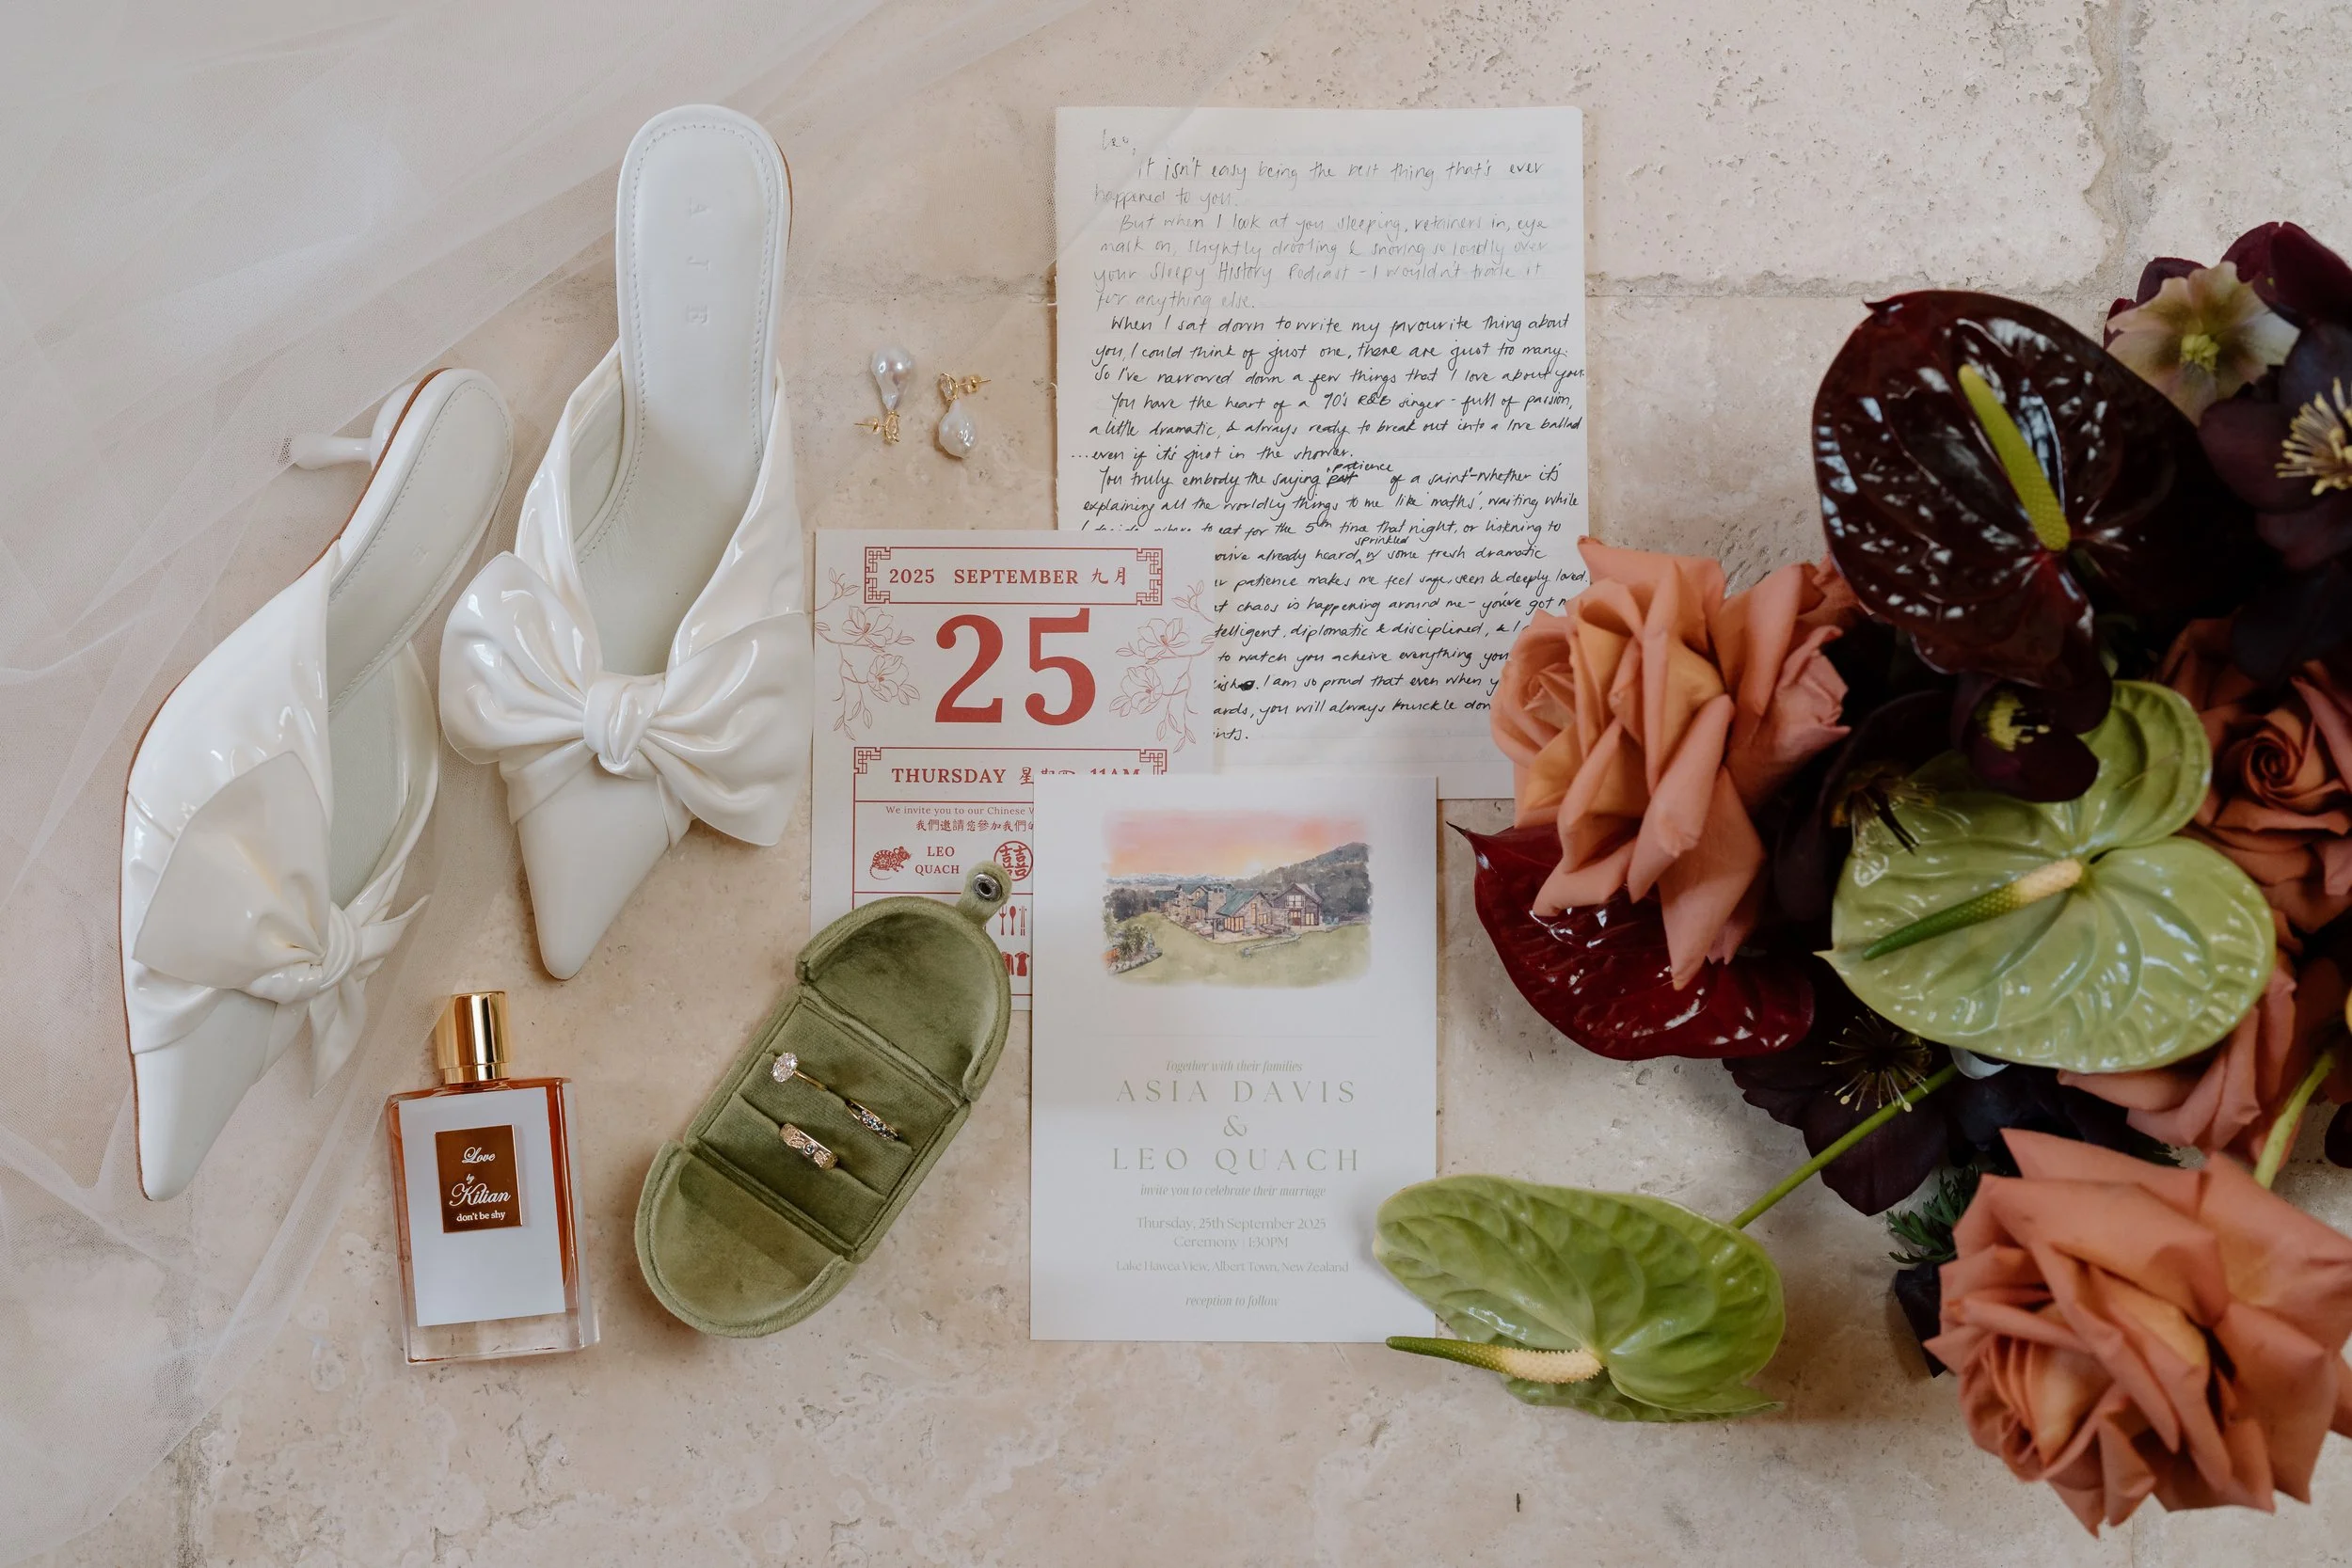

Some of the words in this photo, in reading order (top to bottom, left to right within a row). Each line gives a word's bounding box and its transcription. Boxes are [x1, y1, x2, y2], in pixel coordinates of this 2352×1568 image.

[1166, 156, 1202, 181] isn't
[1212, 164, 1247, 190] easy
[1259, 160, 1297, 191] being
[1310, 161, 1336, 178] the
[1391, 161, 1435, 192] thing
[1446, 159, 1492, 177] that's
[1509, 162, 1545, 174] ever
[1094, 183, 1166, 210] happened
[1175, 187, 1191, 205] to
[1097, 292, 1128, 311] for
[1136, 291, 1211, 317] anything
[1222, 292, 1255, 309] else.
[1165, 314, 1171, 330] I
[1178, 318, 1208, 333] sat
[1217, 318, 1264, 332] down
[1276, 316, 1291, 330] to
[1296, 318, 1343, 332] write
[1352, 321, 1380, 343] my
[1390, 318, 1473, 338] favourite
[1482, 315, 1522, 341] thing
[1528, 313, 1570, 329] about
[1091, 344, 1126, 367] you,
[1130, 342, 1139, 358] I
[1141, 345, 1184, 358] could
[1189, 345, 1235, 359] think
[1242, 349, 1260, 370] of
[1263, 340, 1307, 374] just
[1319, 348, 1351, 359] one,
[1408, 347, 1442, 357] are
[1448, 340, 1491, 371] just
[1094, 364, 1110, 381] So
[1118, 366, 1147, 382] I've
[1157, 370, 1235, 385] narrowed
[1245, 371, 1285, 384] down
[1292, 373, 1303, 382] a
[1309, 372, 1342, 395] few
[1350, 368, 1396, 399] things
[1406, 368, 1438, 382] that
[1450, 368, 1457, 382] I
[1465, 370, 1497, 382] love
[1502, 369, 1549, 382] about
[1111, 392, 1136, 419] You
[1143, 393, 1184, 409] have
[1189, 394, 1218, 409] the
[1225, 396, 1266, 409] heart
[1273, 400, 1291, 422] of
[1358, 392, 1391, 406] R&B
[1398, 393, 1446, 419] singer
[1460, 391, 1497, 416] full
[1501, 398, 1521, 418] of
[1523, 394, 1573, 412] passion,
[1089, 426, 1101, 435] a
[1104, 417, 1139, 436] little
[1149, 420, 1221, 440] dramatic,
[1244, 419, 1297, 447] always
[1309, 420, 1350, 450] ready
[1357, 420, 1372, 434] to
[1376, 419, 1418, 434] break
[1422, 420, 1449, 432] out
[1457, 419, 1486, 431] into
[1506, 417, 1535, 432] love
[1540, 417, 1583, 431] ballad
[1133, 446, 1148, 471] if
[1156, 444, 1178, 461] it's
[1183, 444, 1222, 473] just
[1229, 444, 1246, 459] in
[1257, 445, 1284, 459] the
[1294, 446, 1354, 462] shower.
[889, 568, 935, 584] 2025
[954, 569, 1079, 585] SEPTEMBER
[1090, 566, 1126, 585] 九月
[934, 608, 1097, 726] 25
[1217, 651, 1231, 663] to
[1238, 651, 1287, 663] watch
[1294, 654, 1324, 672] you
[1399, 648, 1473, 670] everything
[1272, 677, 1296, 688] am
[1304, 677, 1317, 688] so
[1323, 675, 1364, 691] proud
[1371, 674, 1404, 688] that
[1409, 676, 1438, 687] even
[891, 768, 1007, 784] THURSDAY
[885, 806, 900, 816] We
[904, 806, 931, 816] invite
[934, 808, 952, 817] you
[954, 806, 964, 816] to
[987, 806, 1025, 816] Chinese
[927, 847, 955, 857] LEO
[915, 864, 960, 875] QUACH
[1166, 1060, 1209, 1073] Together
[1212, 1060, 1233, 1071] with
[1236, 1060, 1261, 1071] their
[1262, 1060, 1303, 1074] families
[1116, 1080, 1209, 1102] ASIA
[1234, 1081, 1354, 1102] DAVIS
[1223, 1115, 1247, 1137] &
[461, 1147, 496, 1164] Love
[1113, 1148, 1187, 1170] LEO
[1216, 1148, 1357, 1175] QUACH
[466, 1173, 475, 1184] by
[449, 1182, 511, 1207] Kilian
[1140, 1184, 1168, 1196] invite
[1171, 1186, 1189, 1197] you
[1192, 1185, 1202, 1196] to
[1205, 1184, 1250, 1196] celebrate
[1253, 1185, 1278, 1196] their
[1279, 1186, 1326, 1199] marriage
[456, 1212, 478, 1222] don't
[479, 1212, 489, 1220] be
[491, 1210, 505, 1221] shy
[1136, 1216, 1196, 1230] Thursday,
[1199, 1216, 1224, 1229] 25th
[1227, 1217, 1295, 1232] September
[1297, 1218, 1327, 1229] 2025
[1173, 1236, 1237, 1249] Ceremony
[1116, 1260, 1141, 1272] Lake
[1212, 1260, 1247, 1272] Albert
[1281, 1261, 1303, 1272] New
[1307, 1261, 1349, 1272] Zealand
[1185, 1295, 1232, 1308] reception
[1235, 1296, 1245, 1307] to
[1247, 1295, 1279, 1309] follow
